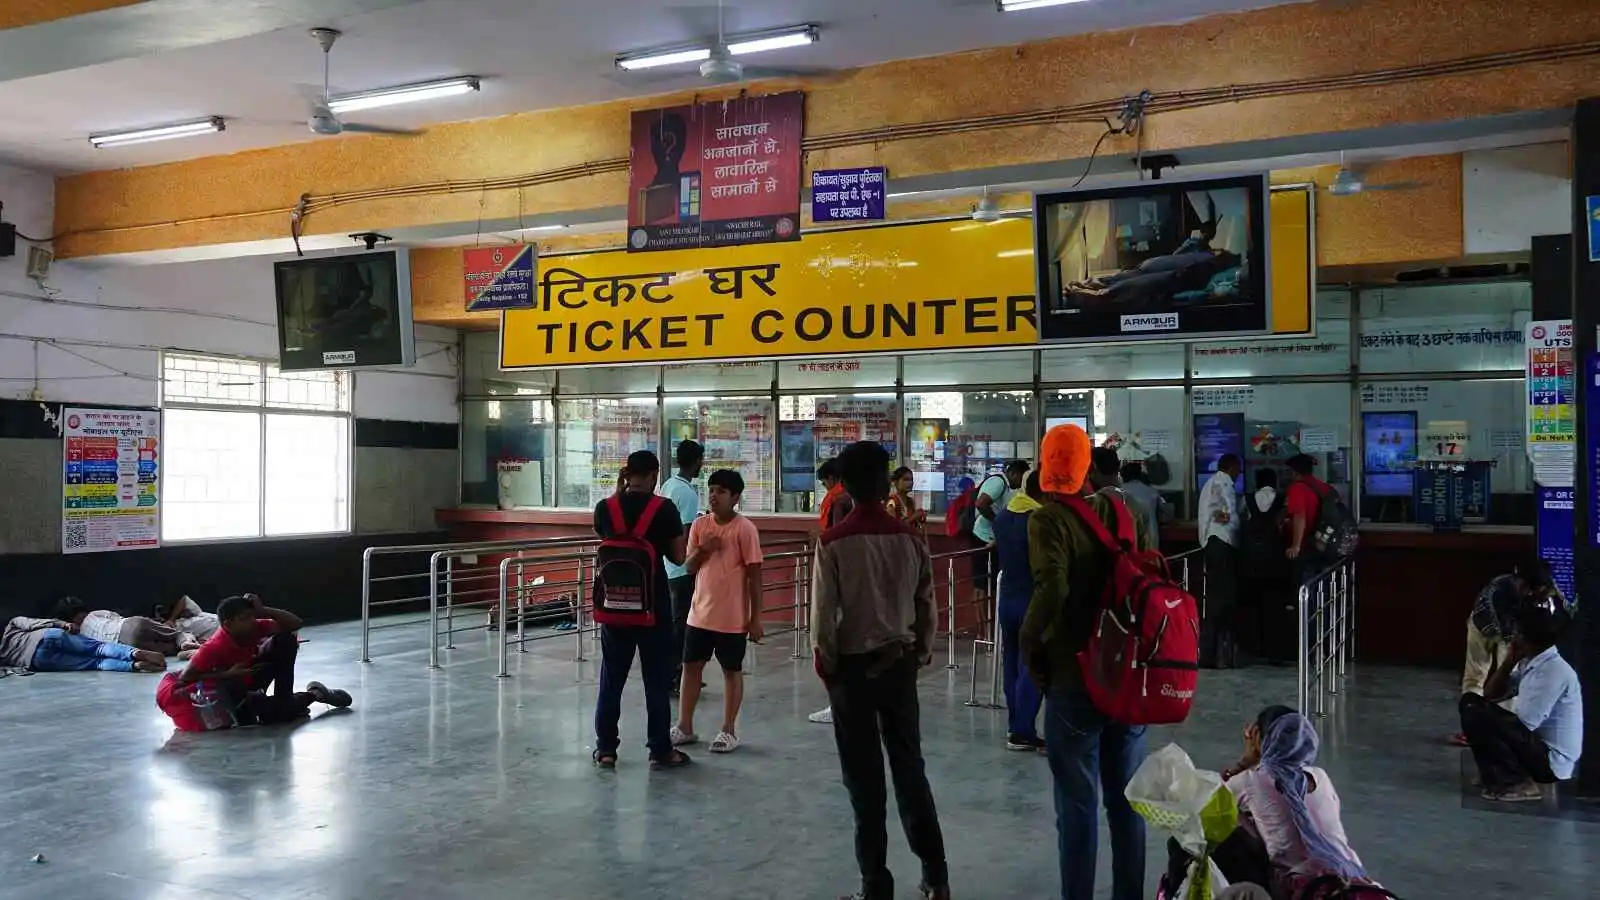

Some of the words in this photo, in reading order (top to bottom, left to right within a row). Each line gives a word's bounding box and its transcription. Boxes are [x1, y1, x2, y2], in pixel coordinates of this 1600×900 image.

[715, 122, 770, 140] सावधान
[703, 138, 759, 159] अनजानों
[714, 159, 769, 179] लावारिस
[710, 177, 758, 198] सामानों
[765, 177, 778, 193] से
[830, 208, 839, 217] पर
[839, 206, 861, 217] उपलब्ध
[539, 268, 677, 312] टिकट
[702, 262, 780, 299] घर
[537, 313, 725, 354] TICKET
[751, 292, 1037, 344] COUNTER
[1124, 316, 1176, 325] ARMOUR
[1544, 338, 1571, 347] UTS
[1541, 368, 1549, 376] 2
[82, 426, 108, 435] मोबाइल
[1436, 442, 1457, 455] 17
[1419, 487, 1434, 505] NO
[1555, 491, 1568, 499] QR
